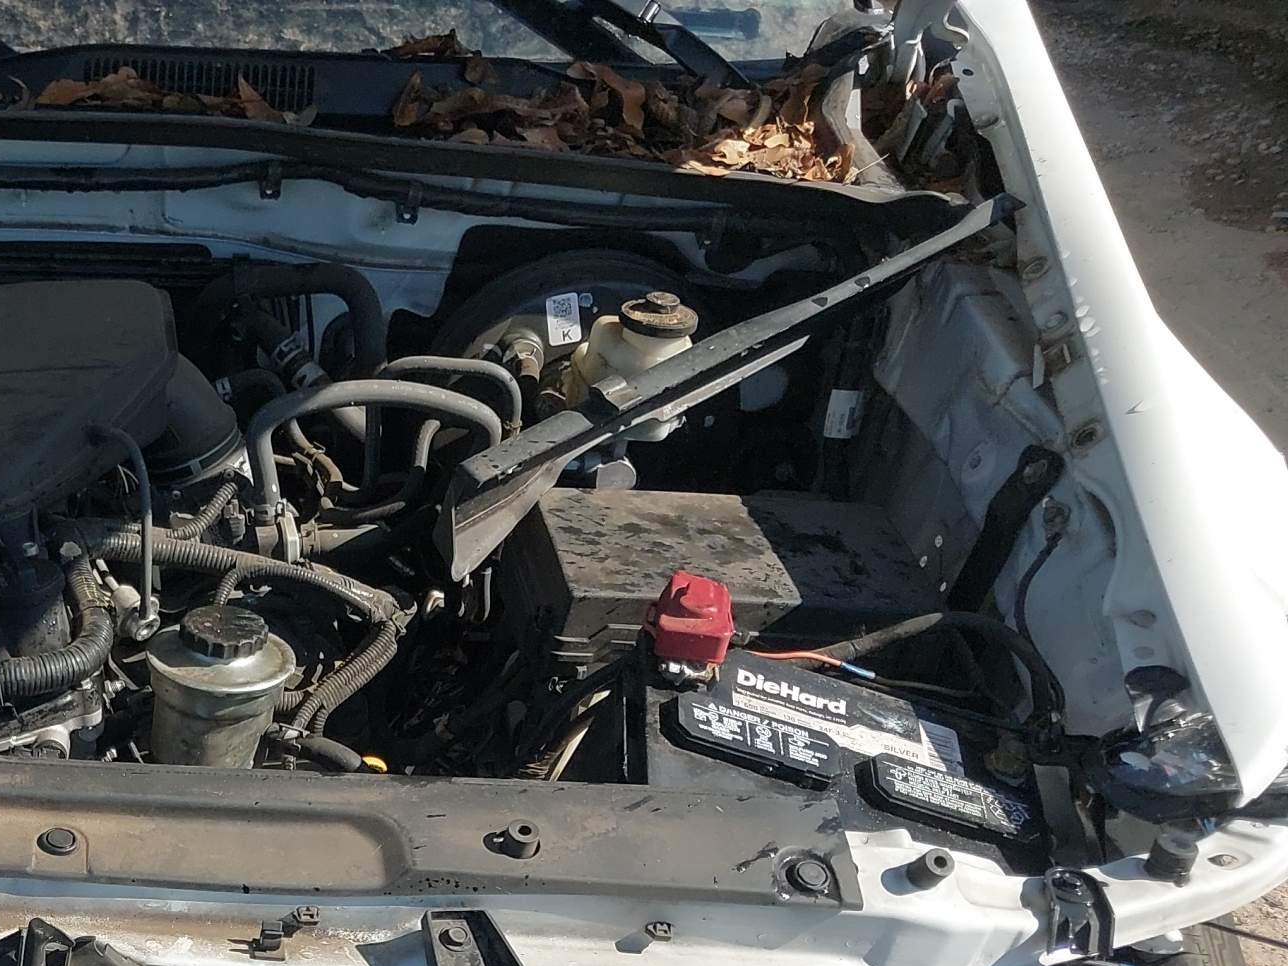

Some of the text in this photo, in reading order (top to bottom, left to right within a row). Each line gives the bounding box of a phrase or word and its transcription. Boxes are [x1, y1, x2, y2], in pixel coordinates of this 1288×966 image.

[562, 328, 573, 342] K
[736, 667, 847, 716] DieHard
[719, 705, 761, 723] DANGER
[772, 721, 809, 739] POISON
[883, 743, 920, 760] SILVER
